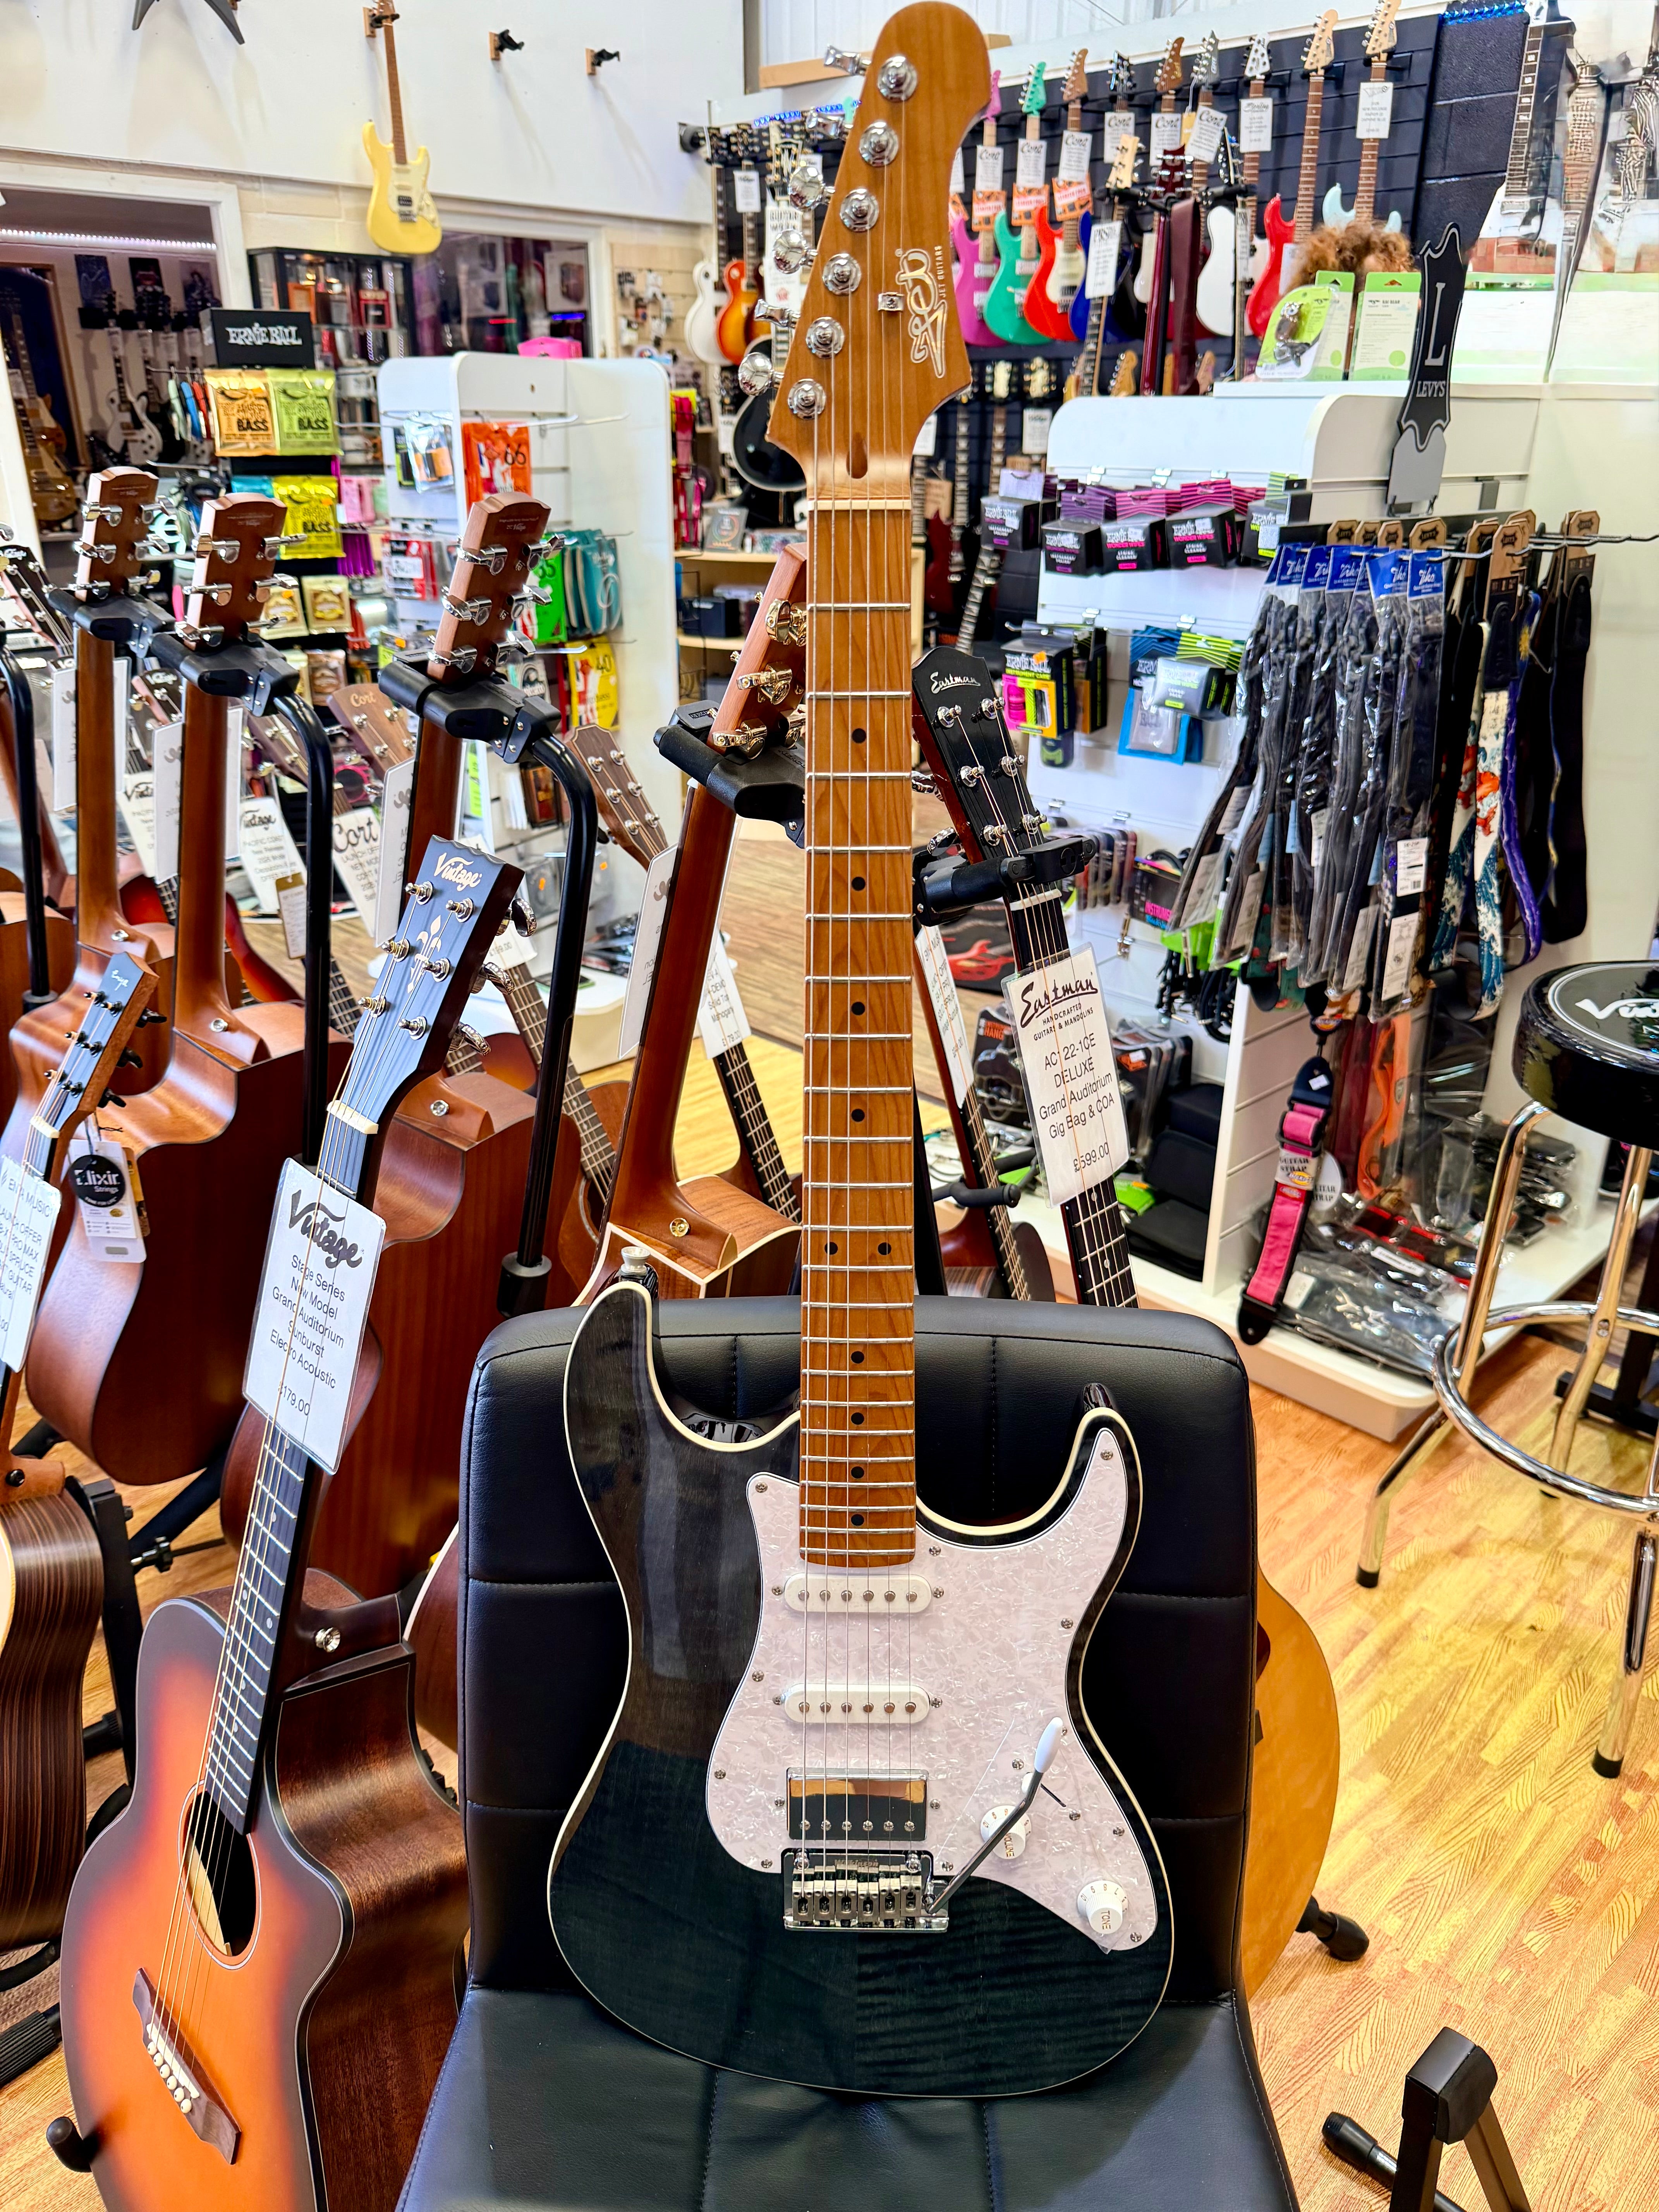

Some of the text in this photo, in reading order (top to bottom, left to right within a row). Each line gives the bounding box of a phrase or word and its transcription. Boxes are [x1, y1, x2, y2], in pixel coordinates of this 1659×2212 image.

[1108, 114, 1132, 129] Cort
[1155, 114, 1179, 129] Cort
[1199, 110, 1224, 127] Cort
[1022, 141, 1042, 154] Cort
[1065, 134, 1089, 148] Cort
[934, 245, 945, 280] GUITARS
[225, 322, 302, 345] ERNIE BALL
[1425, 283, 1446, 366] L
[237, 418, 268, 431] BASS
[298, 418, 329, 430] BASS
[505, 443, 526, 465] 66
[1419, 569, 1436, 586] Ziko
[597, 654, 611, 674] 40
[1005, 653, 1030, 670] ERNIE
[1137, 659, 1158, 674] ERN
[931, 672, 981, 693] Eastman
[350, 693, 376, 708] Cort
[334, 817, 378, 853] Cort
[434, 852, 482, 891] Vintage
[1020, 972, 1098, 1028] Eastman
[1034, 1007, 1094, 1041] GUITARS & MANDOLINS
[1042, 1002, 1082, 1025] HANDCRAFTED
[721, 1029, 742, 1047] £79.00
[1054, 1056, 1094, 1088] DELUXE
[1039, 1072, 1113, 1121] Grand Auditorium
[1049, 1092, 1115, 1140] Gig Bag & COA
[1073, 1141, 1110, 1173] £599.00
[74, 1170, 120, 1185] Elixir
[94, 1186, 119, 1194] Strings
[1314, 1185, 1336, 1194] UITAR
[25, 1190, 51, 1218] MUSIC
[0, 1207, 19, 1227] AUNCH
[19, 1223, 42, 1246] OFFER
[289, 1189, 362, 1269] Vintage
[9, 1250, 35, 1278] SPRUCE
[23, 1243, 40, 1262] MAX
[8, 1268, 33, 1295] GUITAR
[291, 1254, 345, 1302] Stage Series
[291, 1278, 338, 1320] New Model
[272, 1286, 345, 1349] Grand Auditorium
[288, 1320, 325, 1358] Sunburst
[297, 1355, 337, 1389] Acoustic
[278, 1380, 311, 1417] £179.00
[1101, 1910, 1111, 1930] TONE
